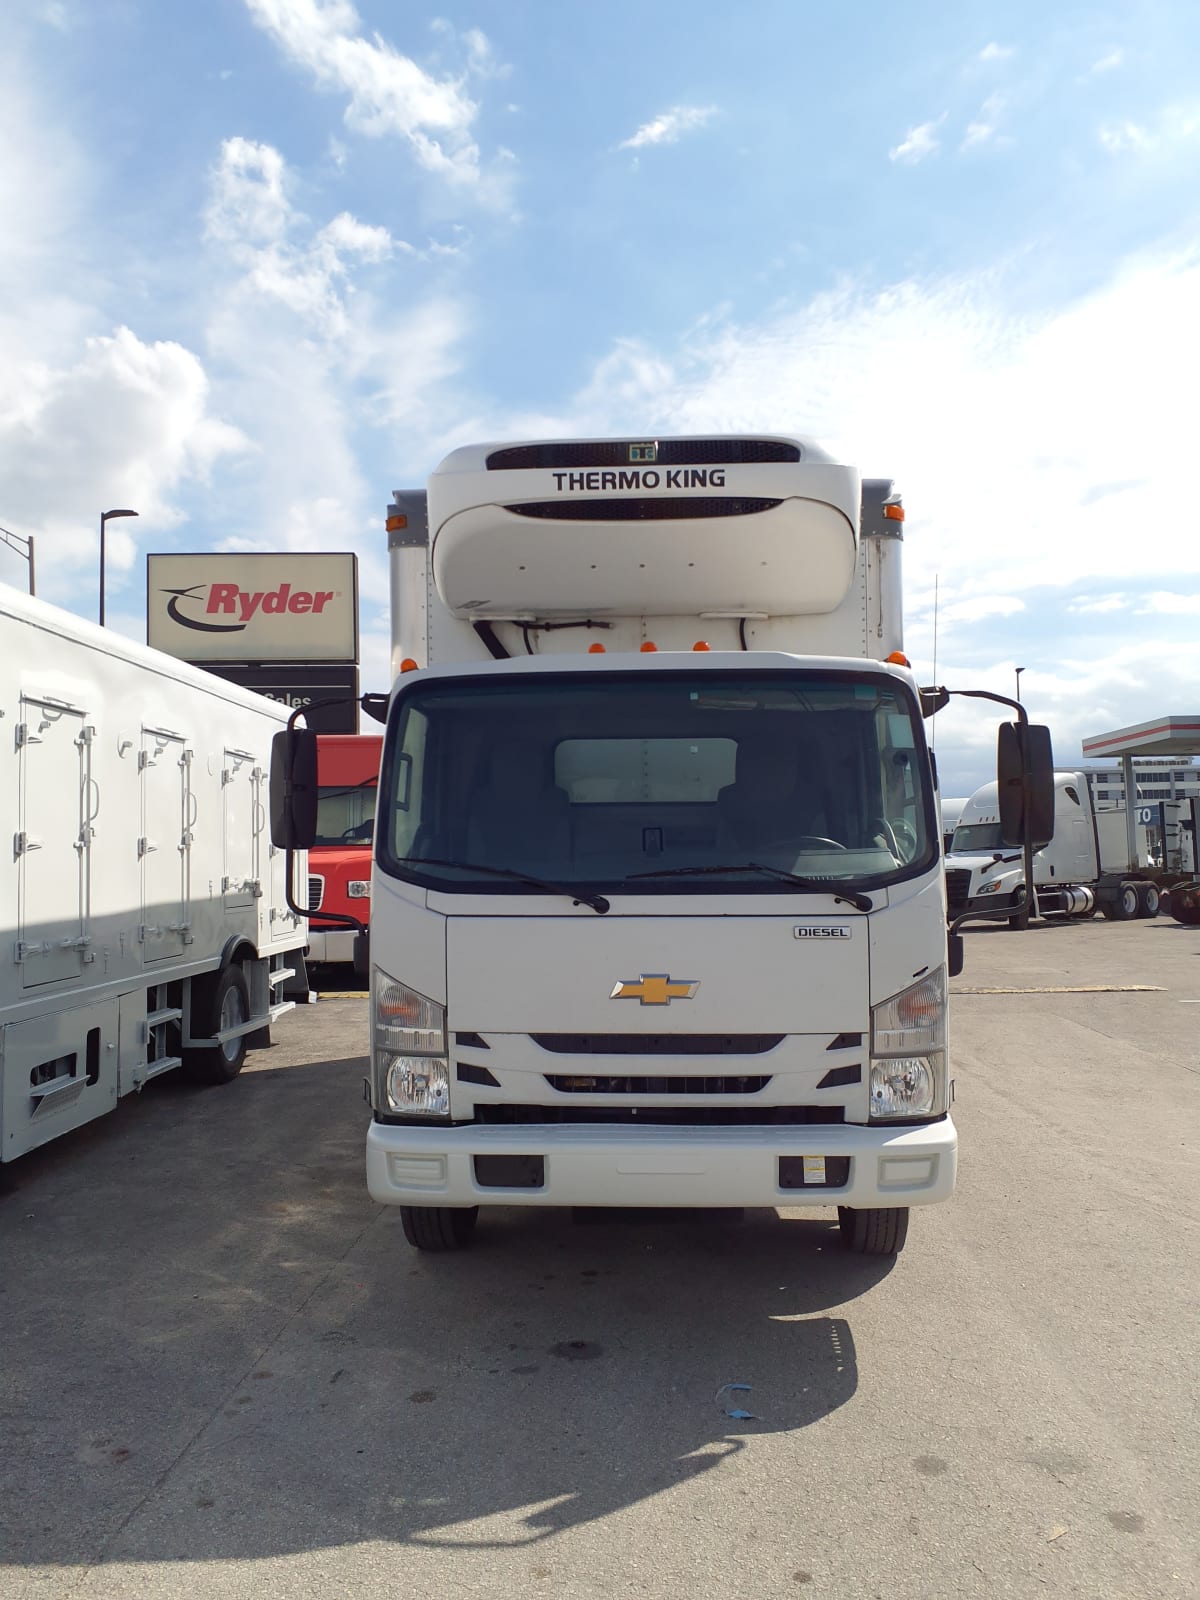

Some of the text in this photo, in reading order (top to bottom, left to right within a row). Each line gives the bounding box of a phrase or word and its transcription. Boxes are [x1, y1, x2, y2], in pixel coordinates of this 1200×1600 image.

[552, 468, 726, 492] THERMO KING
[206, 583, 334, 621] Ryder
[798, 928, 848, 937] DIESEL
